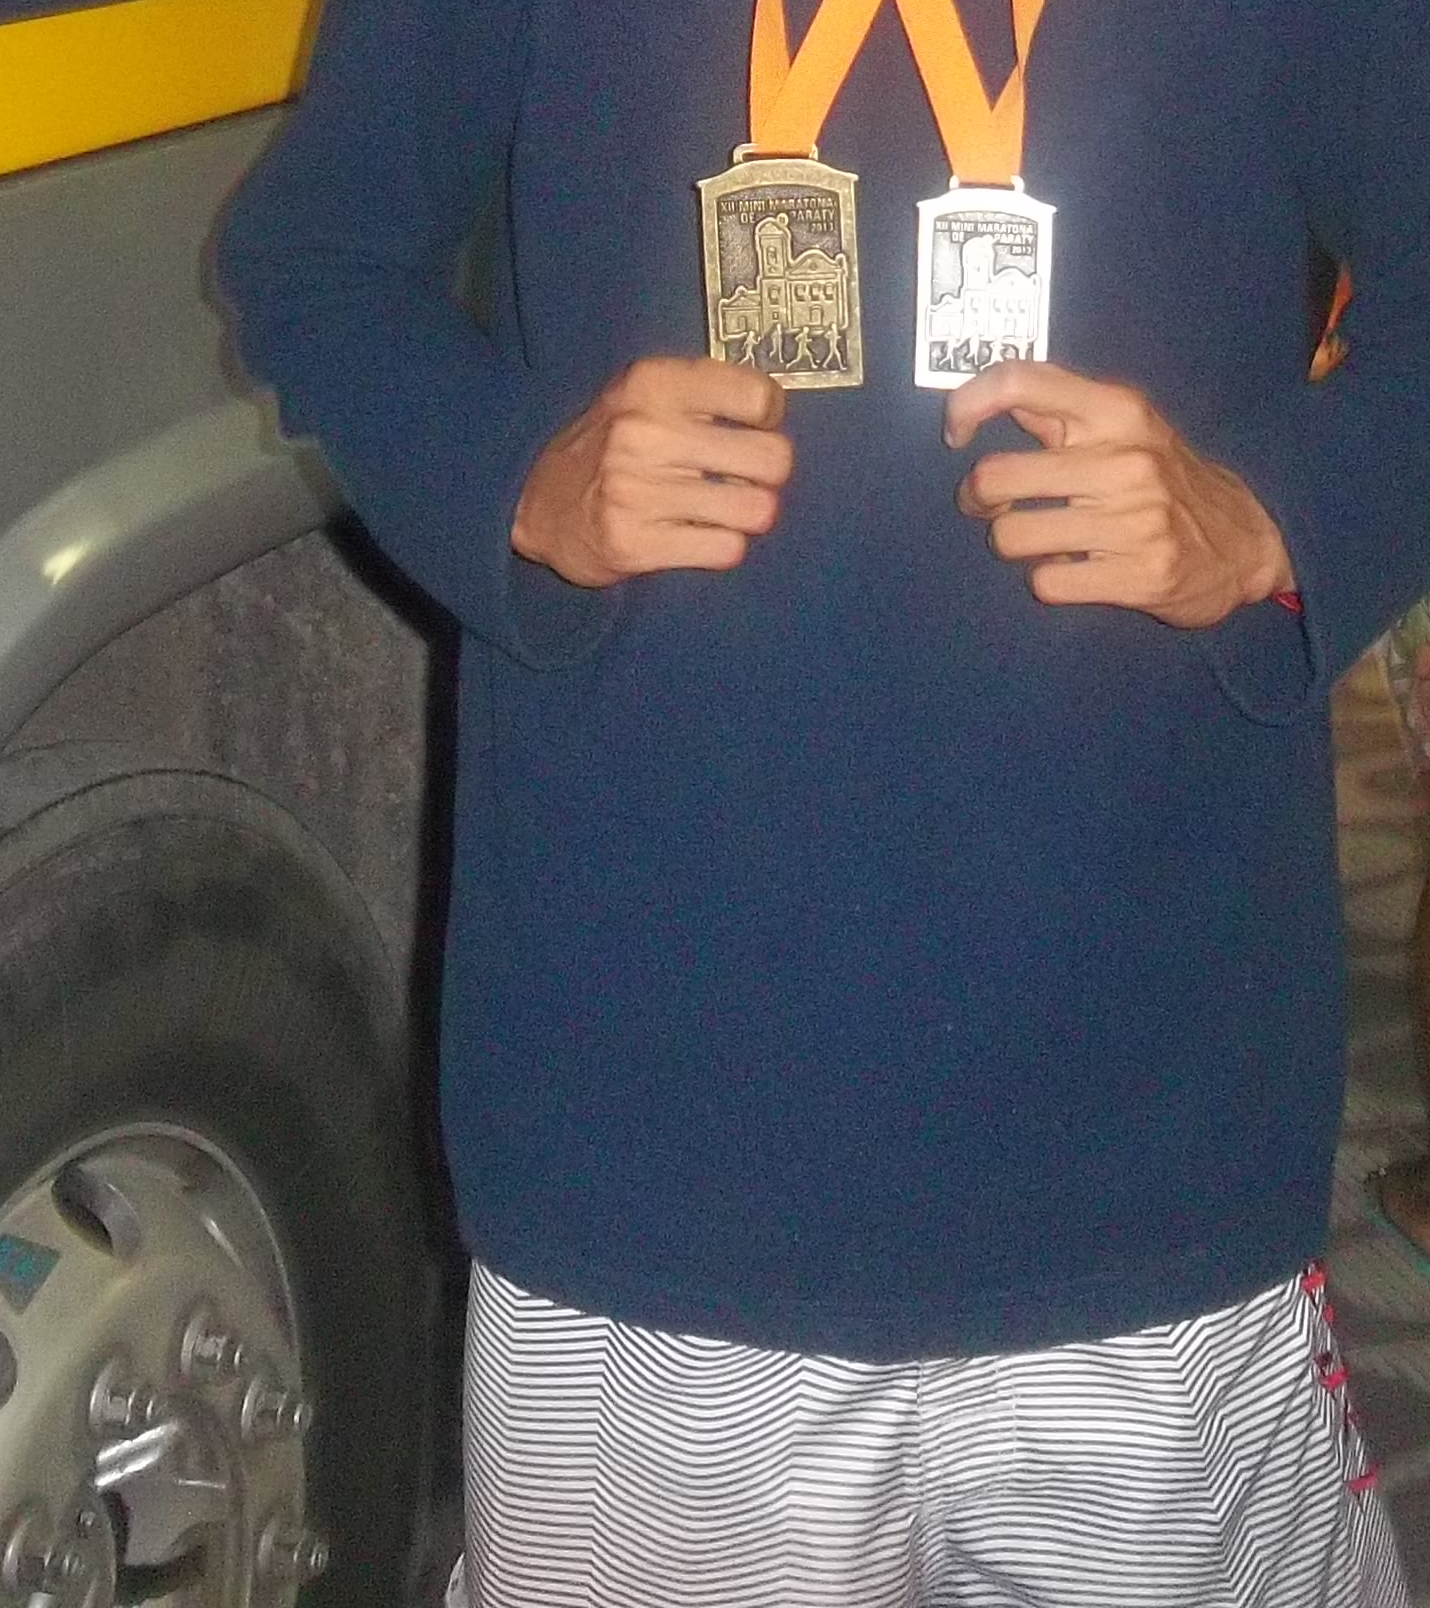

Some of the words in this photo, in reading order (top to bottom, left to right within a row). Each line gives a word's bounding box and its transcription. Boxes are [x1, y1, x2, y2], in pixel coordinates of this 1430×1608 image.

[720, 200, 735, 212] XII
[738, 200, 766, 212] MINI
[740, 212, 756, 223] DE
[935, 221, 949, 231] XII
[951, 221, 975, 232] MINI
[977, 223, 1033, 233] MARATONA
[952, 231, 965, 242] DE
[994, 233, 1035, 244] PARATY
